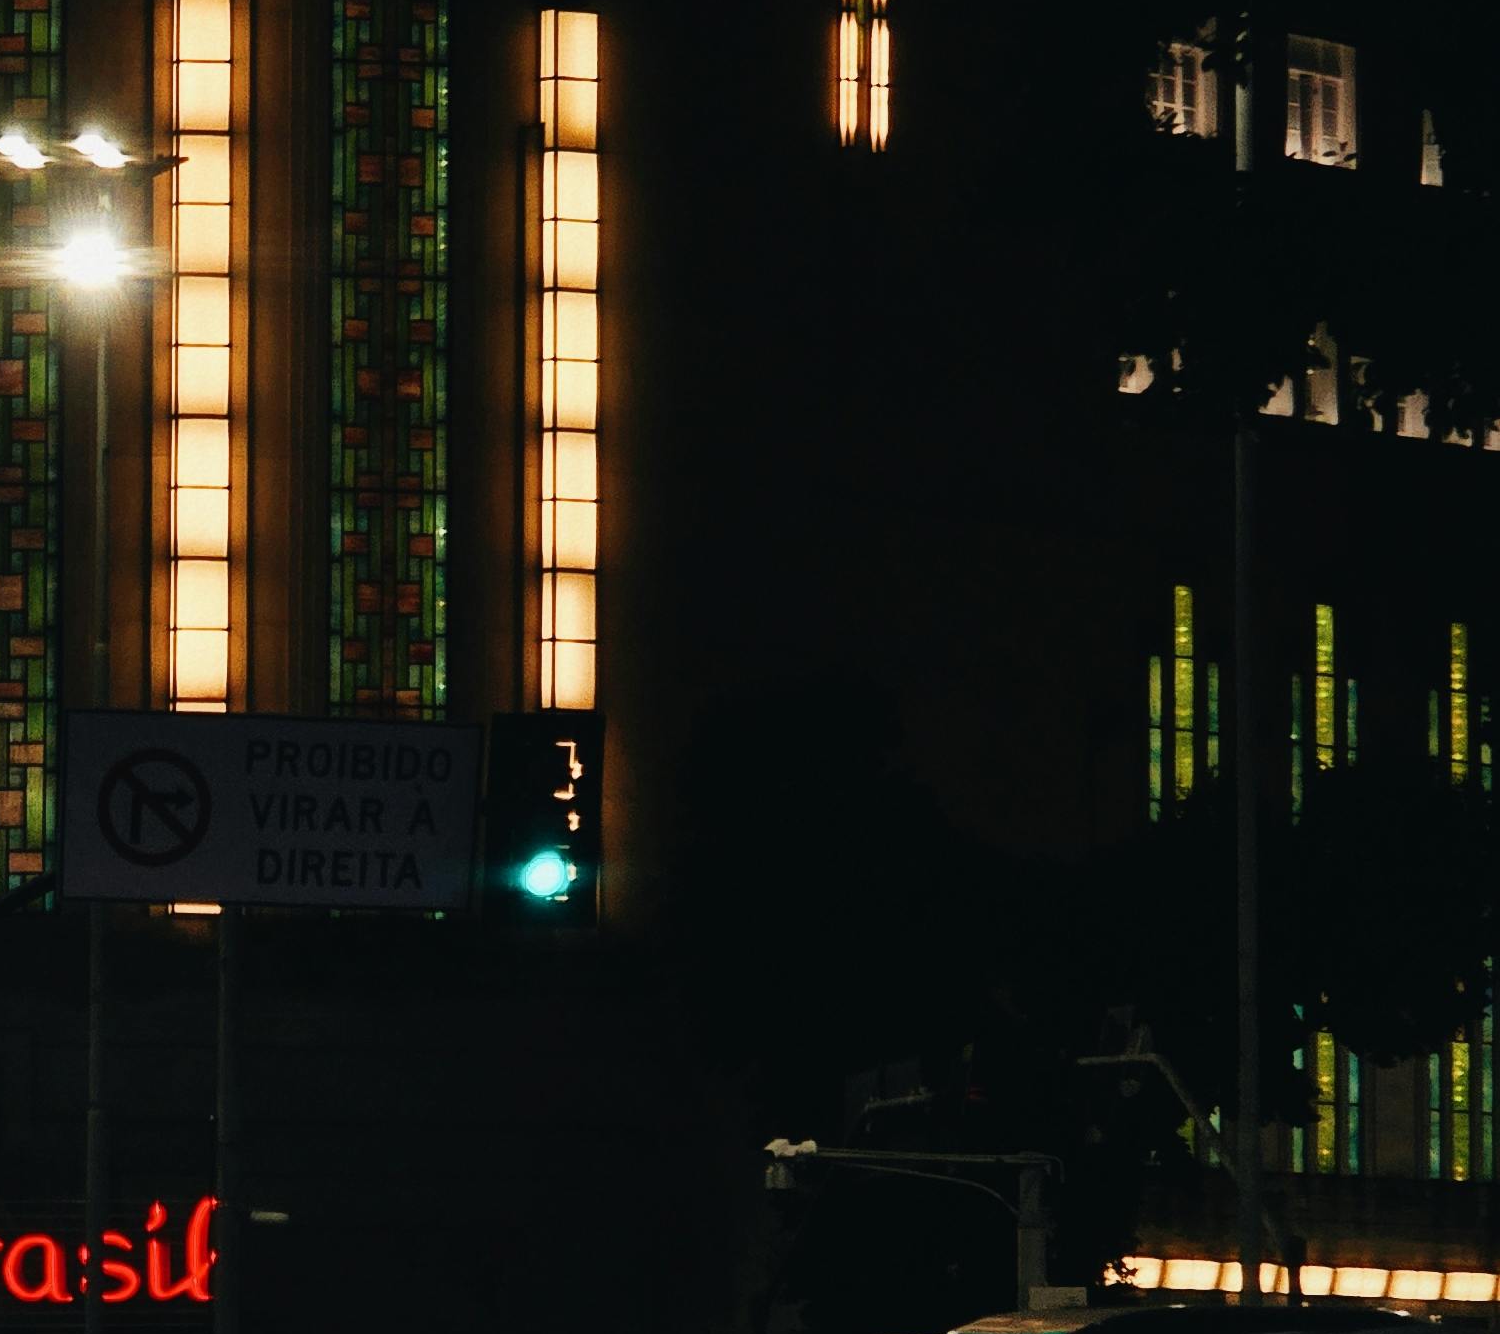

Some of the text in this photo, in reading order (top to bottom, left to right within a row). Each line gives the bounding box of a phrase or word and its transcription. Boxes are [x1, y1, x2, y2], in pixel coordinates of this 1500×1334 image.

[246, 740, 452, 782] PROIBIDO
[250, 794, 384, 833] VIRAR
[257, 848, 422, 888] DIREITA
